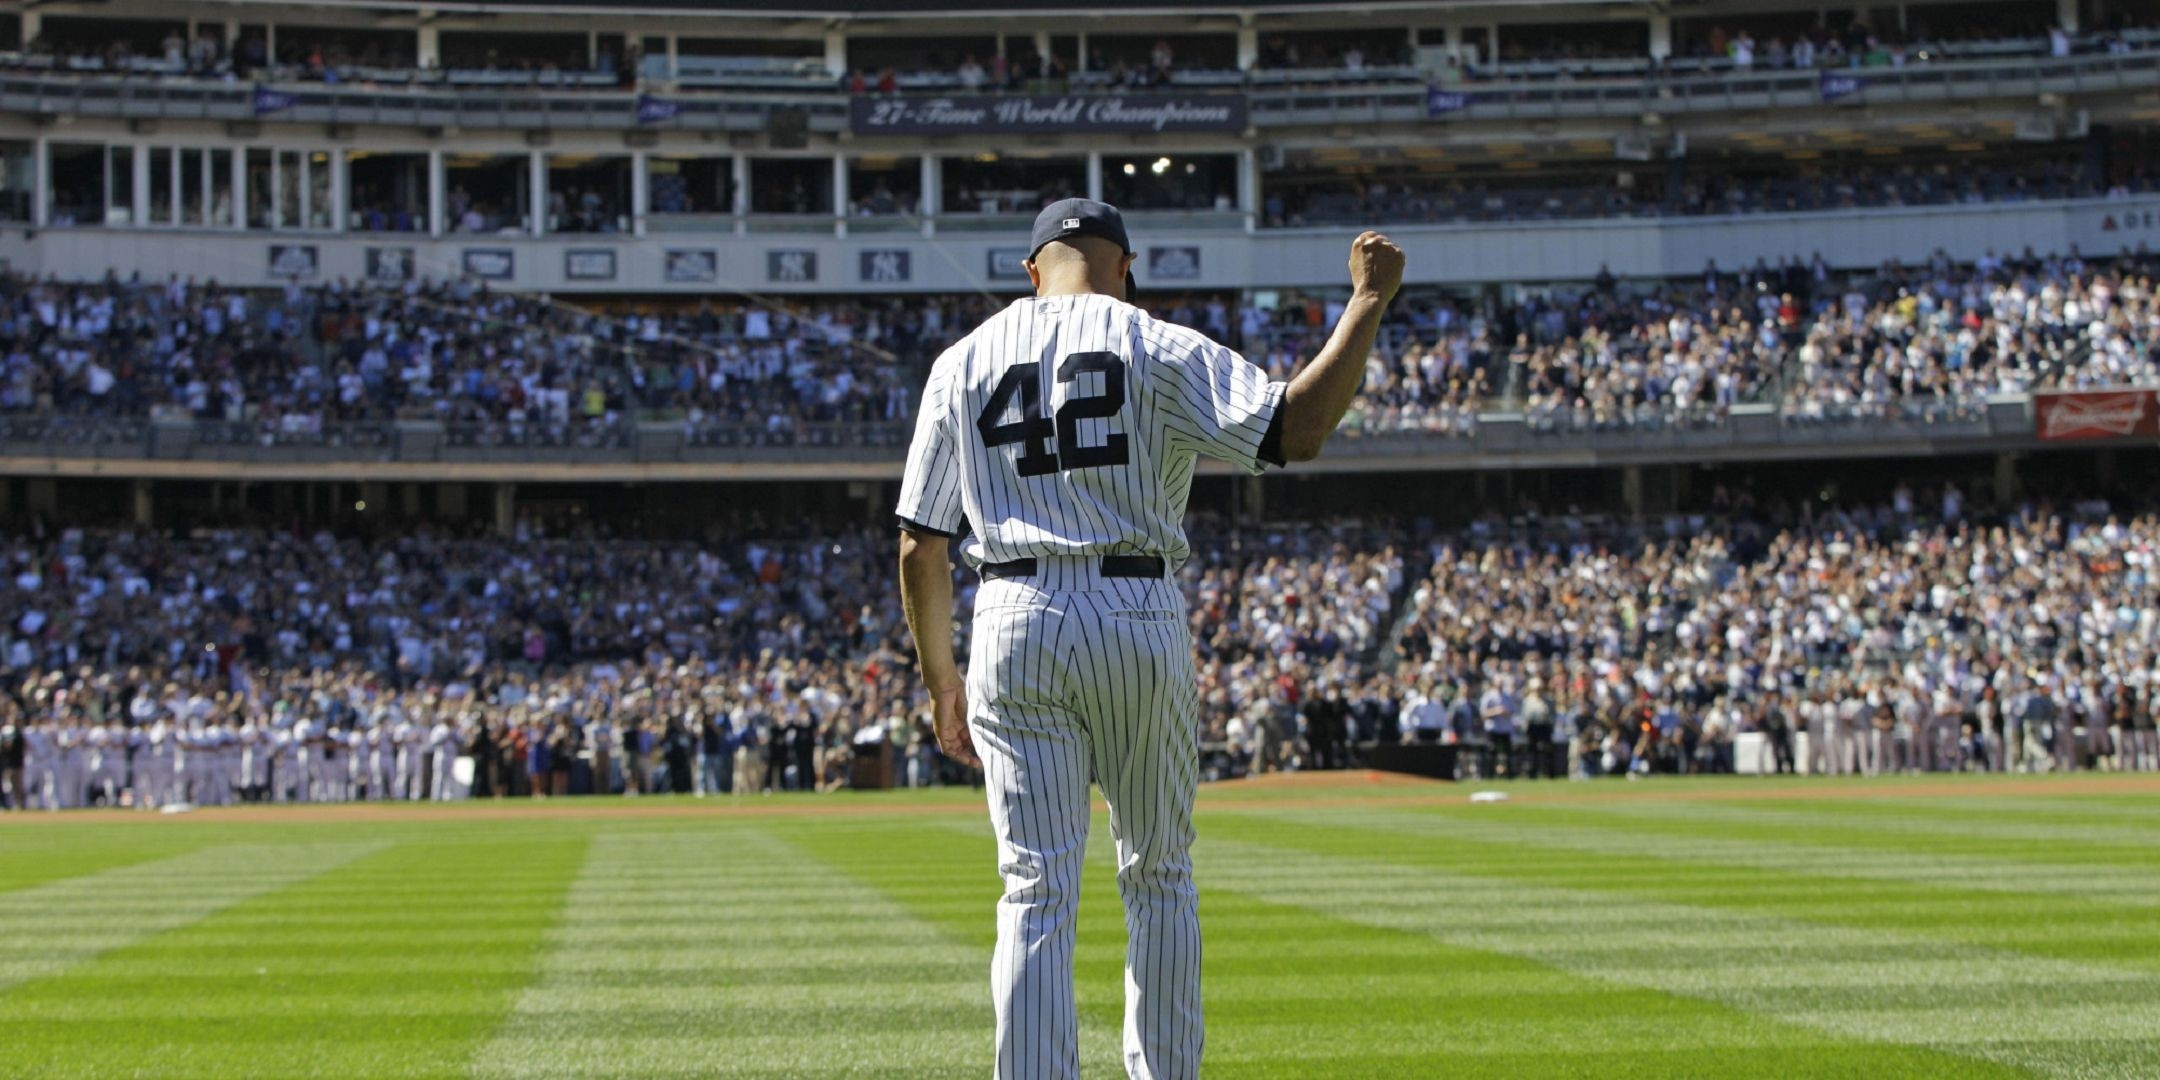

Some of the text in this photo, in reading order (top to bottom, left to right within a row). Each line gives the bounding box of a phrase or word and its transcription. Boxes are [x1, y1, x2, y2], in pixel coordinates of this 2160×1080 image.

[867, 99, 1231, 131] 27-Time World Champions
[2123, 211, 2160, 230] DE
[977, 351, 1129, 477] 42
